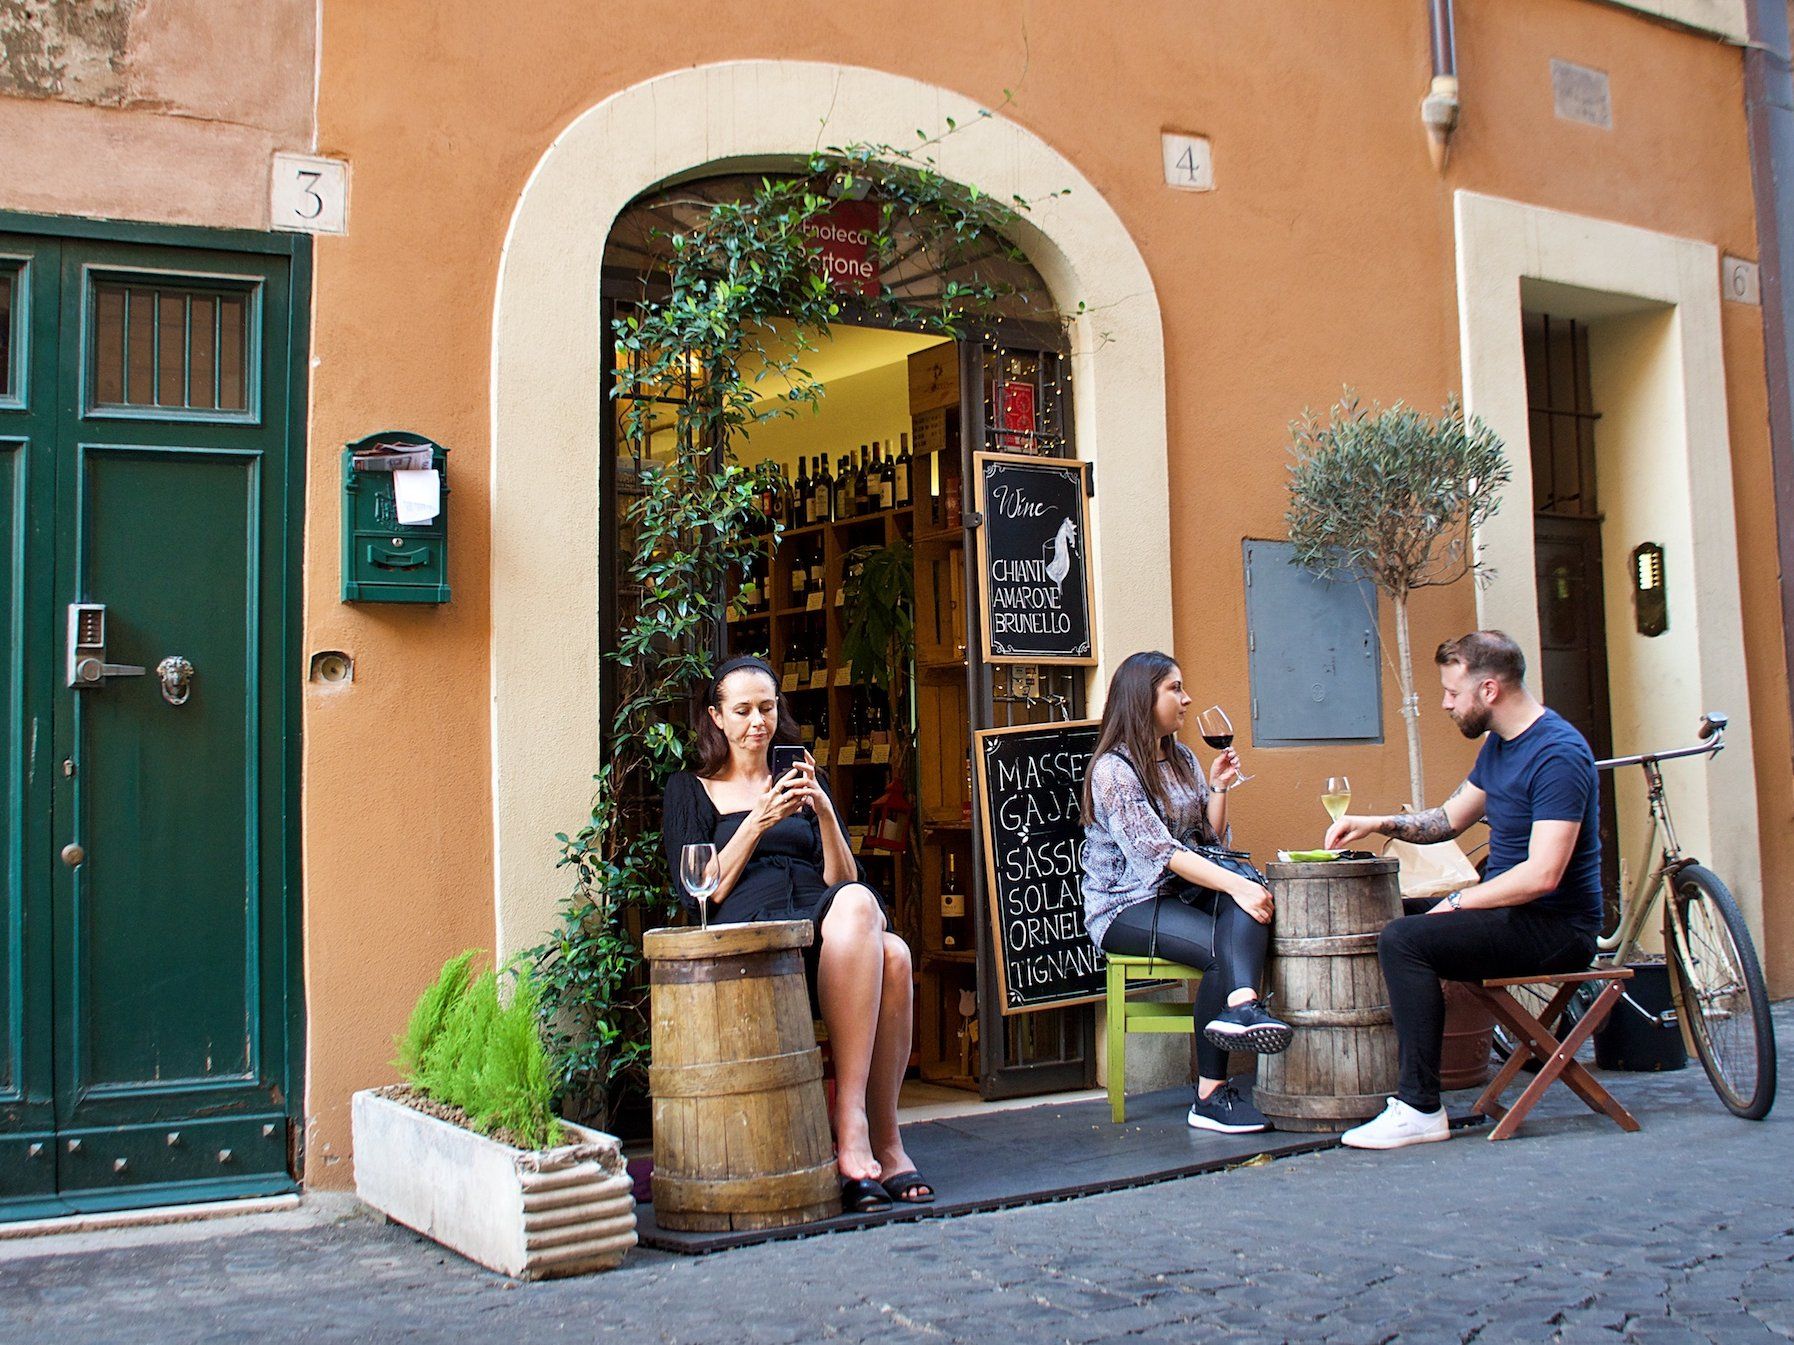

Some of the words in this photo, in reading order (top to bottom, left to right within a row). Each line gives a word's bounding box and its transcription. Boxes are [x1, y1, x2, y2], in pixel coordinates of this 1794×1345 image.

[1176, 145, 1200, 182] 4
[295, 170, 323, 219] 3
[1733, 265, 1749, 296] 6
[993, 484, 1058, 519] Wine
[993, 586, 1061, 609] AMARONE
[994, 612, 1071, 633] BRUNELLO
[1000, 787, 1081, 830] GAJA
[1010, 911, 1088, 951] ORNEL
